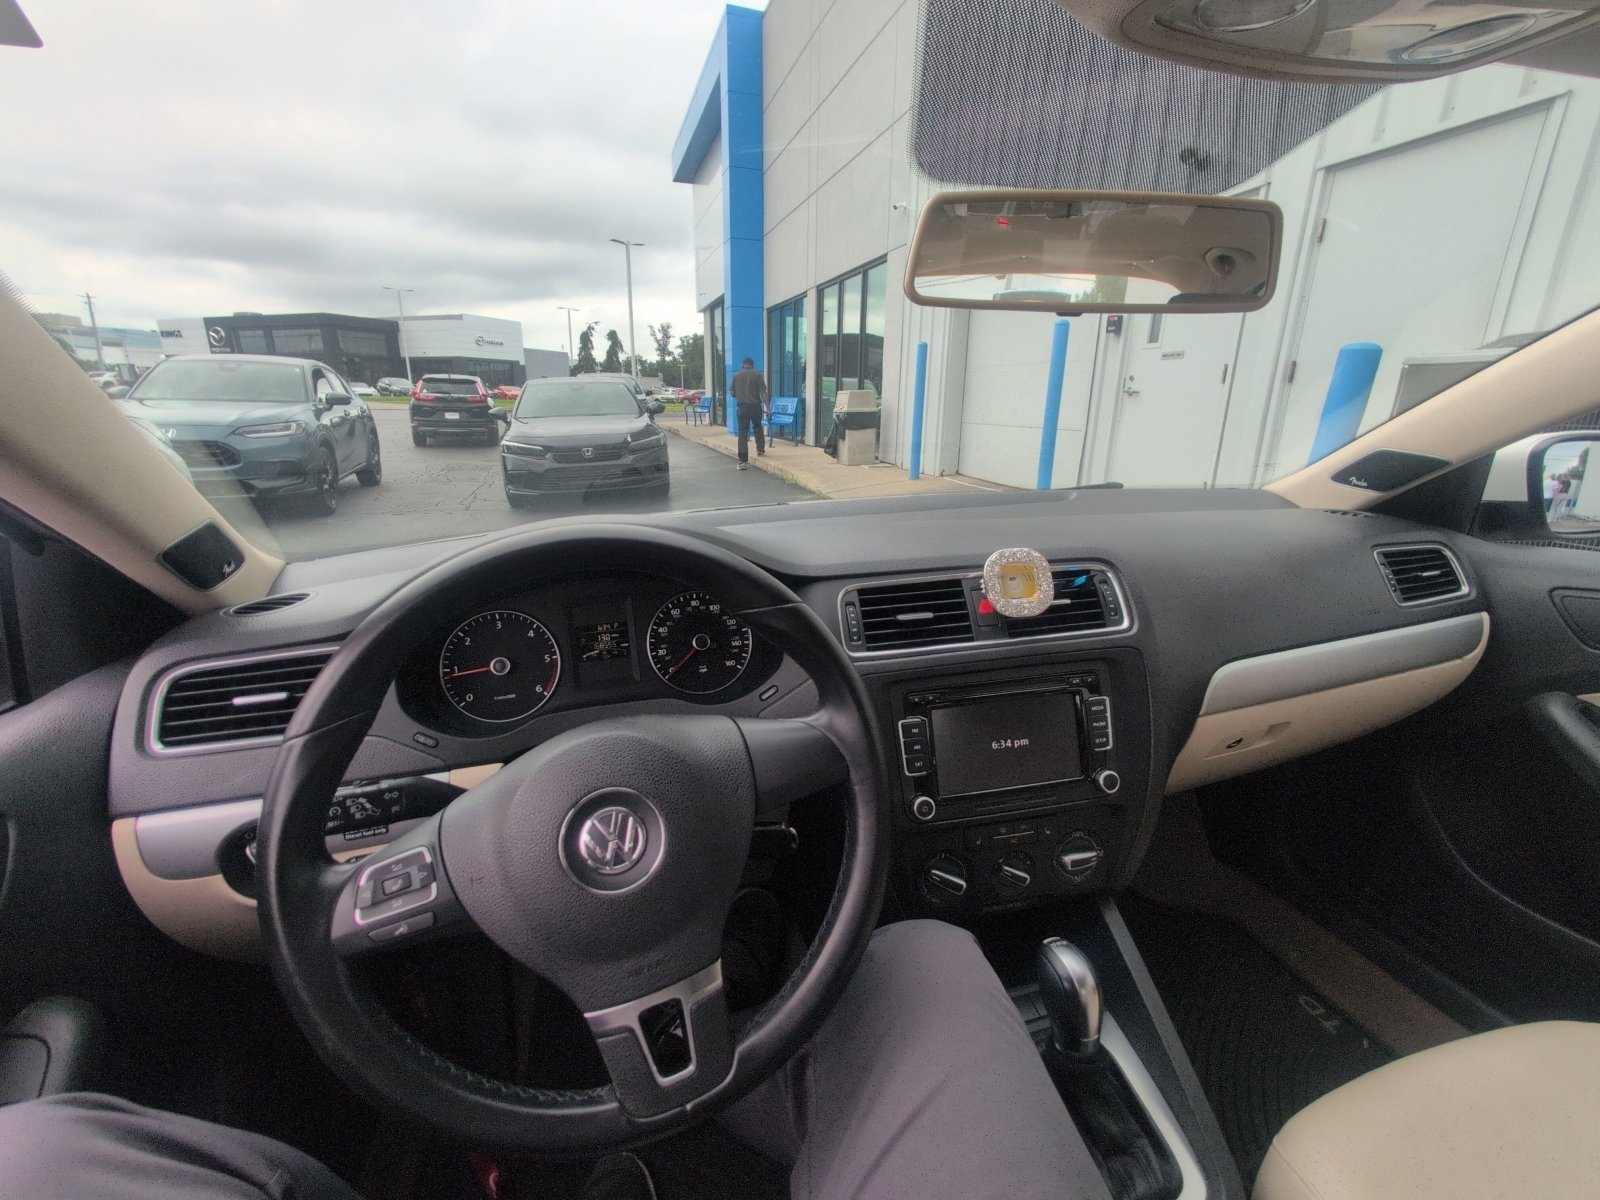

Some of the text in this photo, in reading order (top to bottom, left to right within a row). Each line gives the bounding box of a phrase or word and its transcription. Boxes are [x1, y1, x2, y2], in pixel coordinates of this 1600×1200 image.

[496, 621, 502, 630] 3
[527, 630, 535, 638] 4
[464, 637, 472, 646] 2
[544, 654, 551, 663] 5
[453, 665, 458, 674] 1
[535, 684, 543, 693] 6
[465, 693, 474, 702] 0
[991, 738, 1029, 750] 6:34 pm
